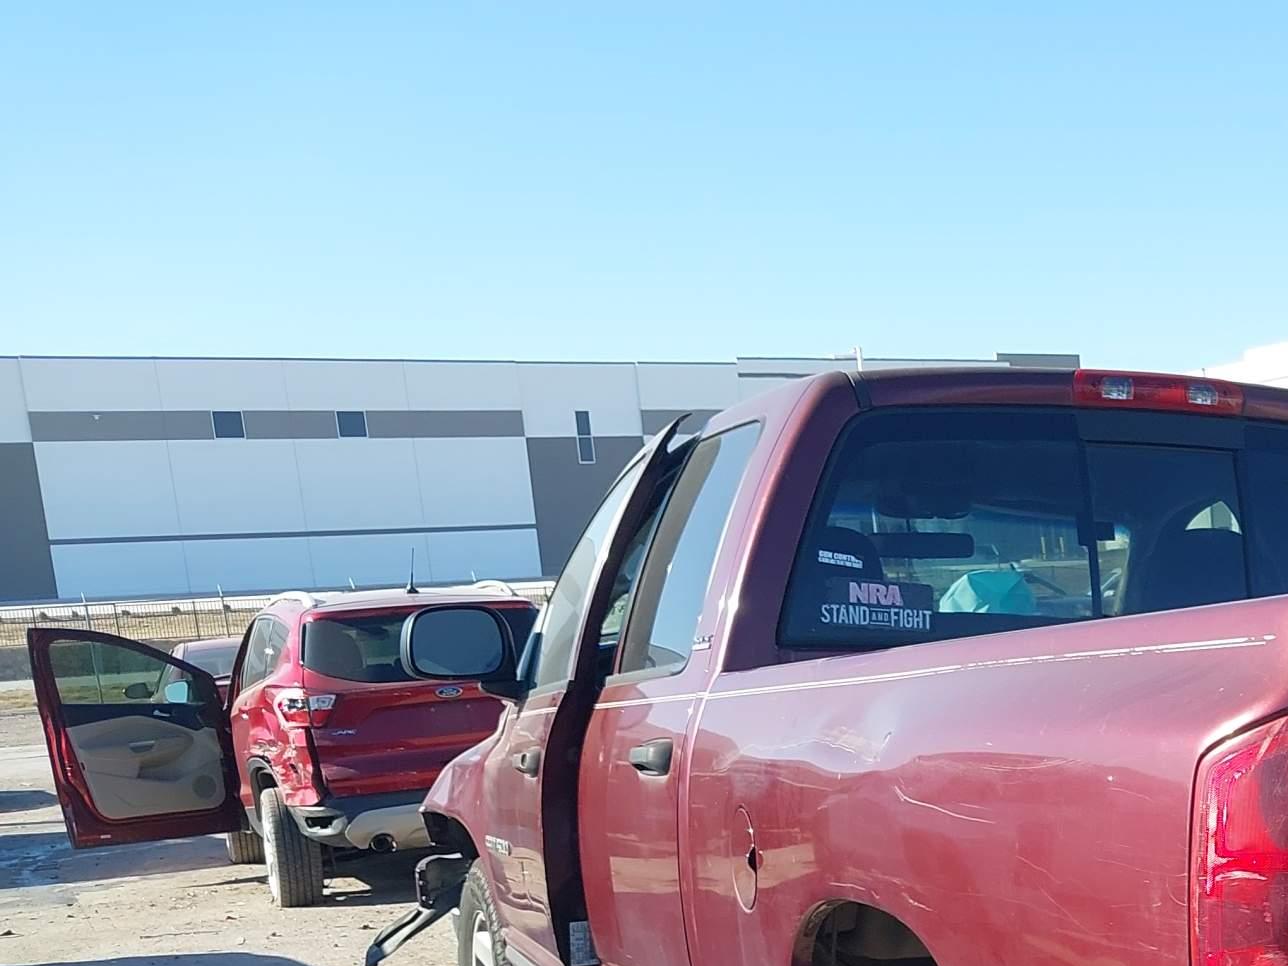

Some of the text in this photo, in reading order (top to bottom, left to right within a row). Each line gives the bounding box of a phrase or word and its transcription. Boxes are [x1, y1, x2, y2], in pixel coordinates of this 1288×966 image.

[849, 582, 904, 606] NRA
[820, 604, 932, 630] STAND AND FIGHT
